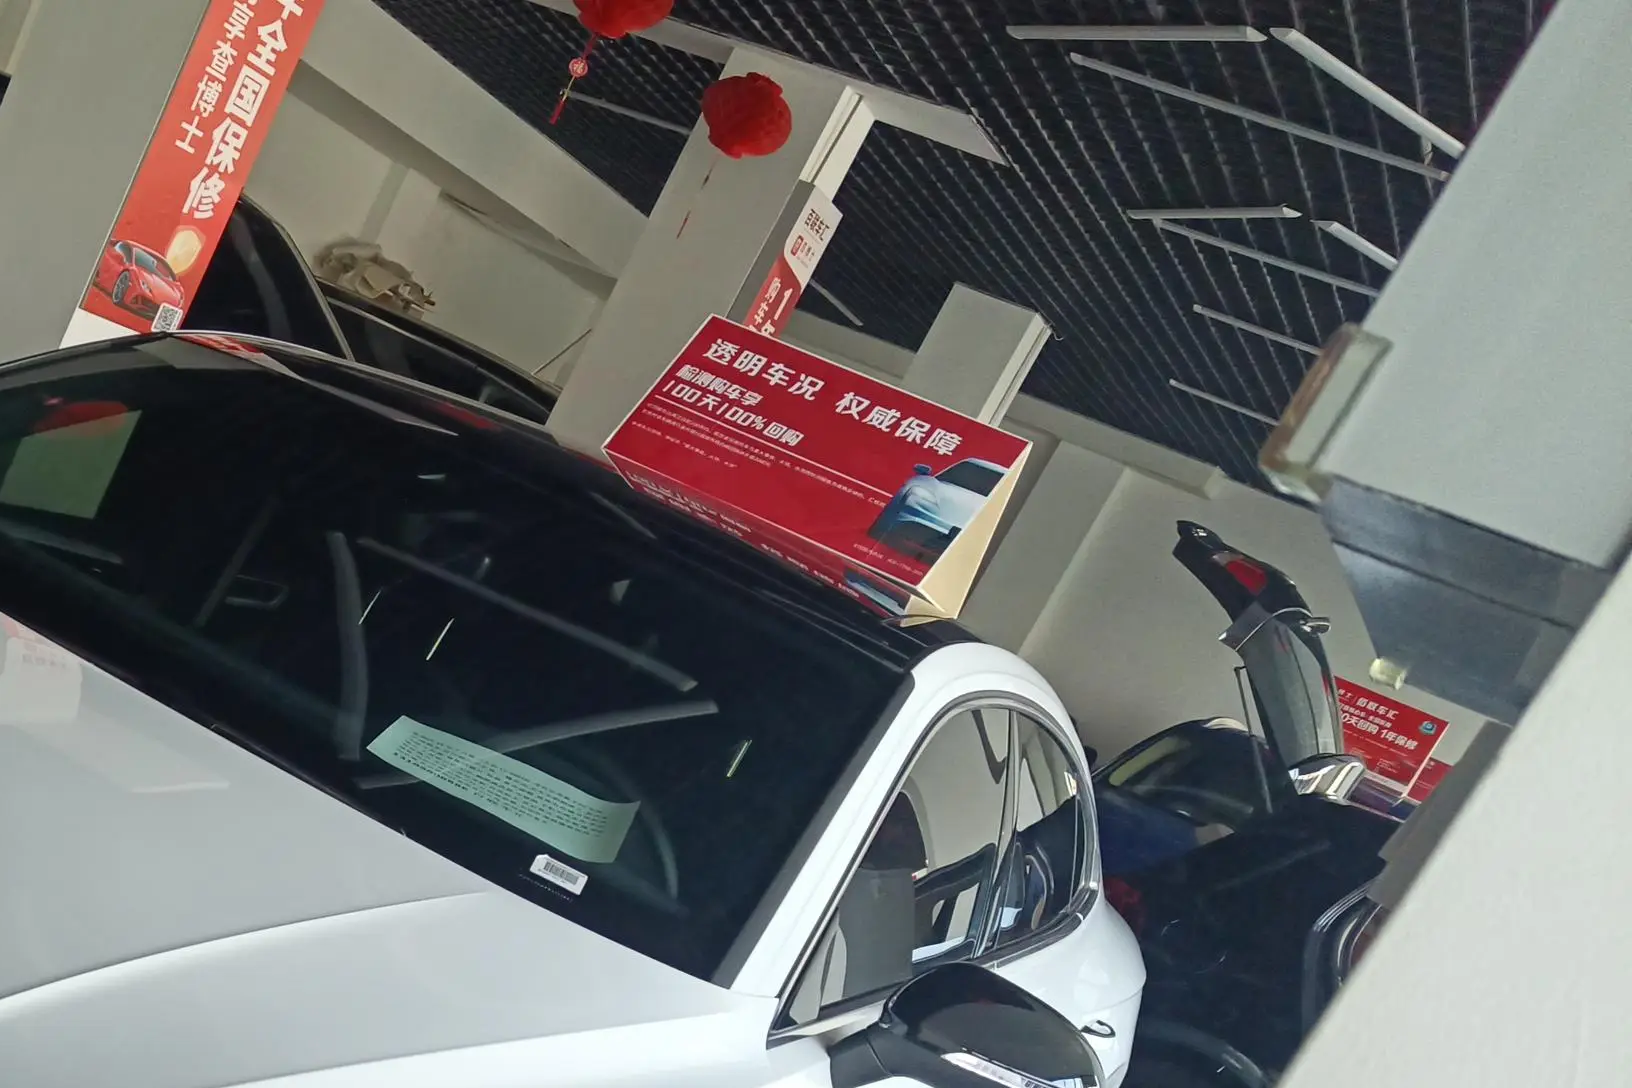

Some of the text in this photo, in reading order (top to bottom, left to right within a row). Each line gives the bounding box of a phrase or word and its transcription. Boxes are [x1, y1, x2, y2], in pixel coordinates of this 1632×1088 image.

[175, 0, 257, 154] 享查博士
[748, 277, 781, 331] 购车
[675, 364, 764, 407] 检测购车享
[702, 338, 825, 402] 透明车况
[834, 391, 964, 457] 权威保障
[1340, 711, 1379, 735] 0天回购
